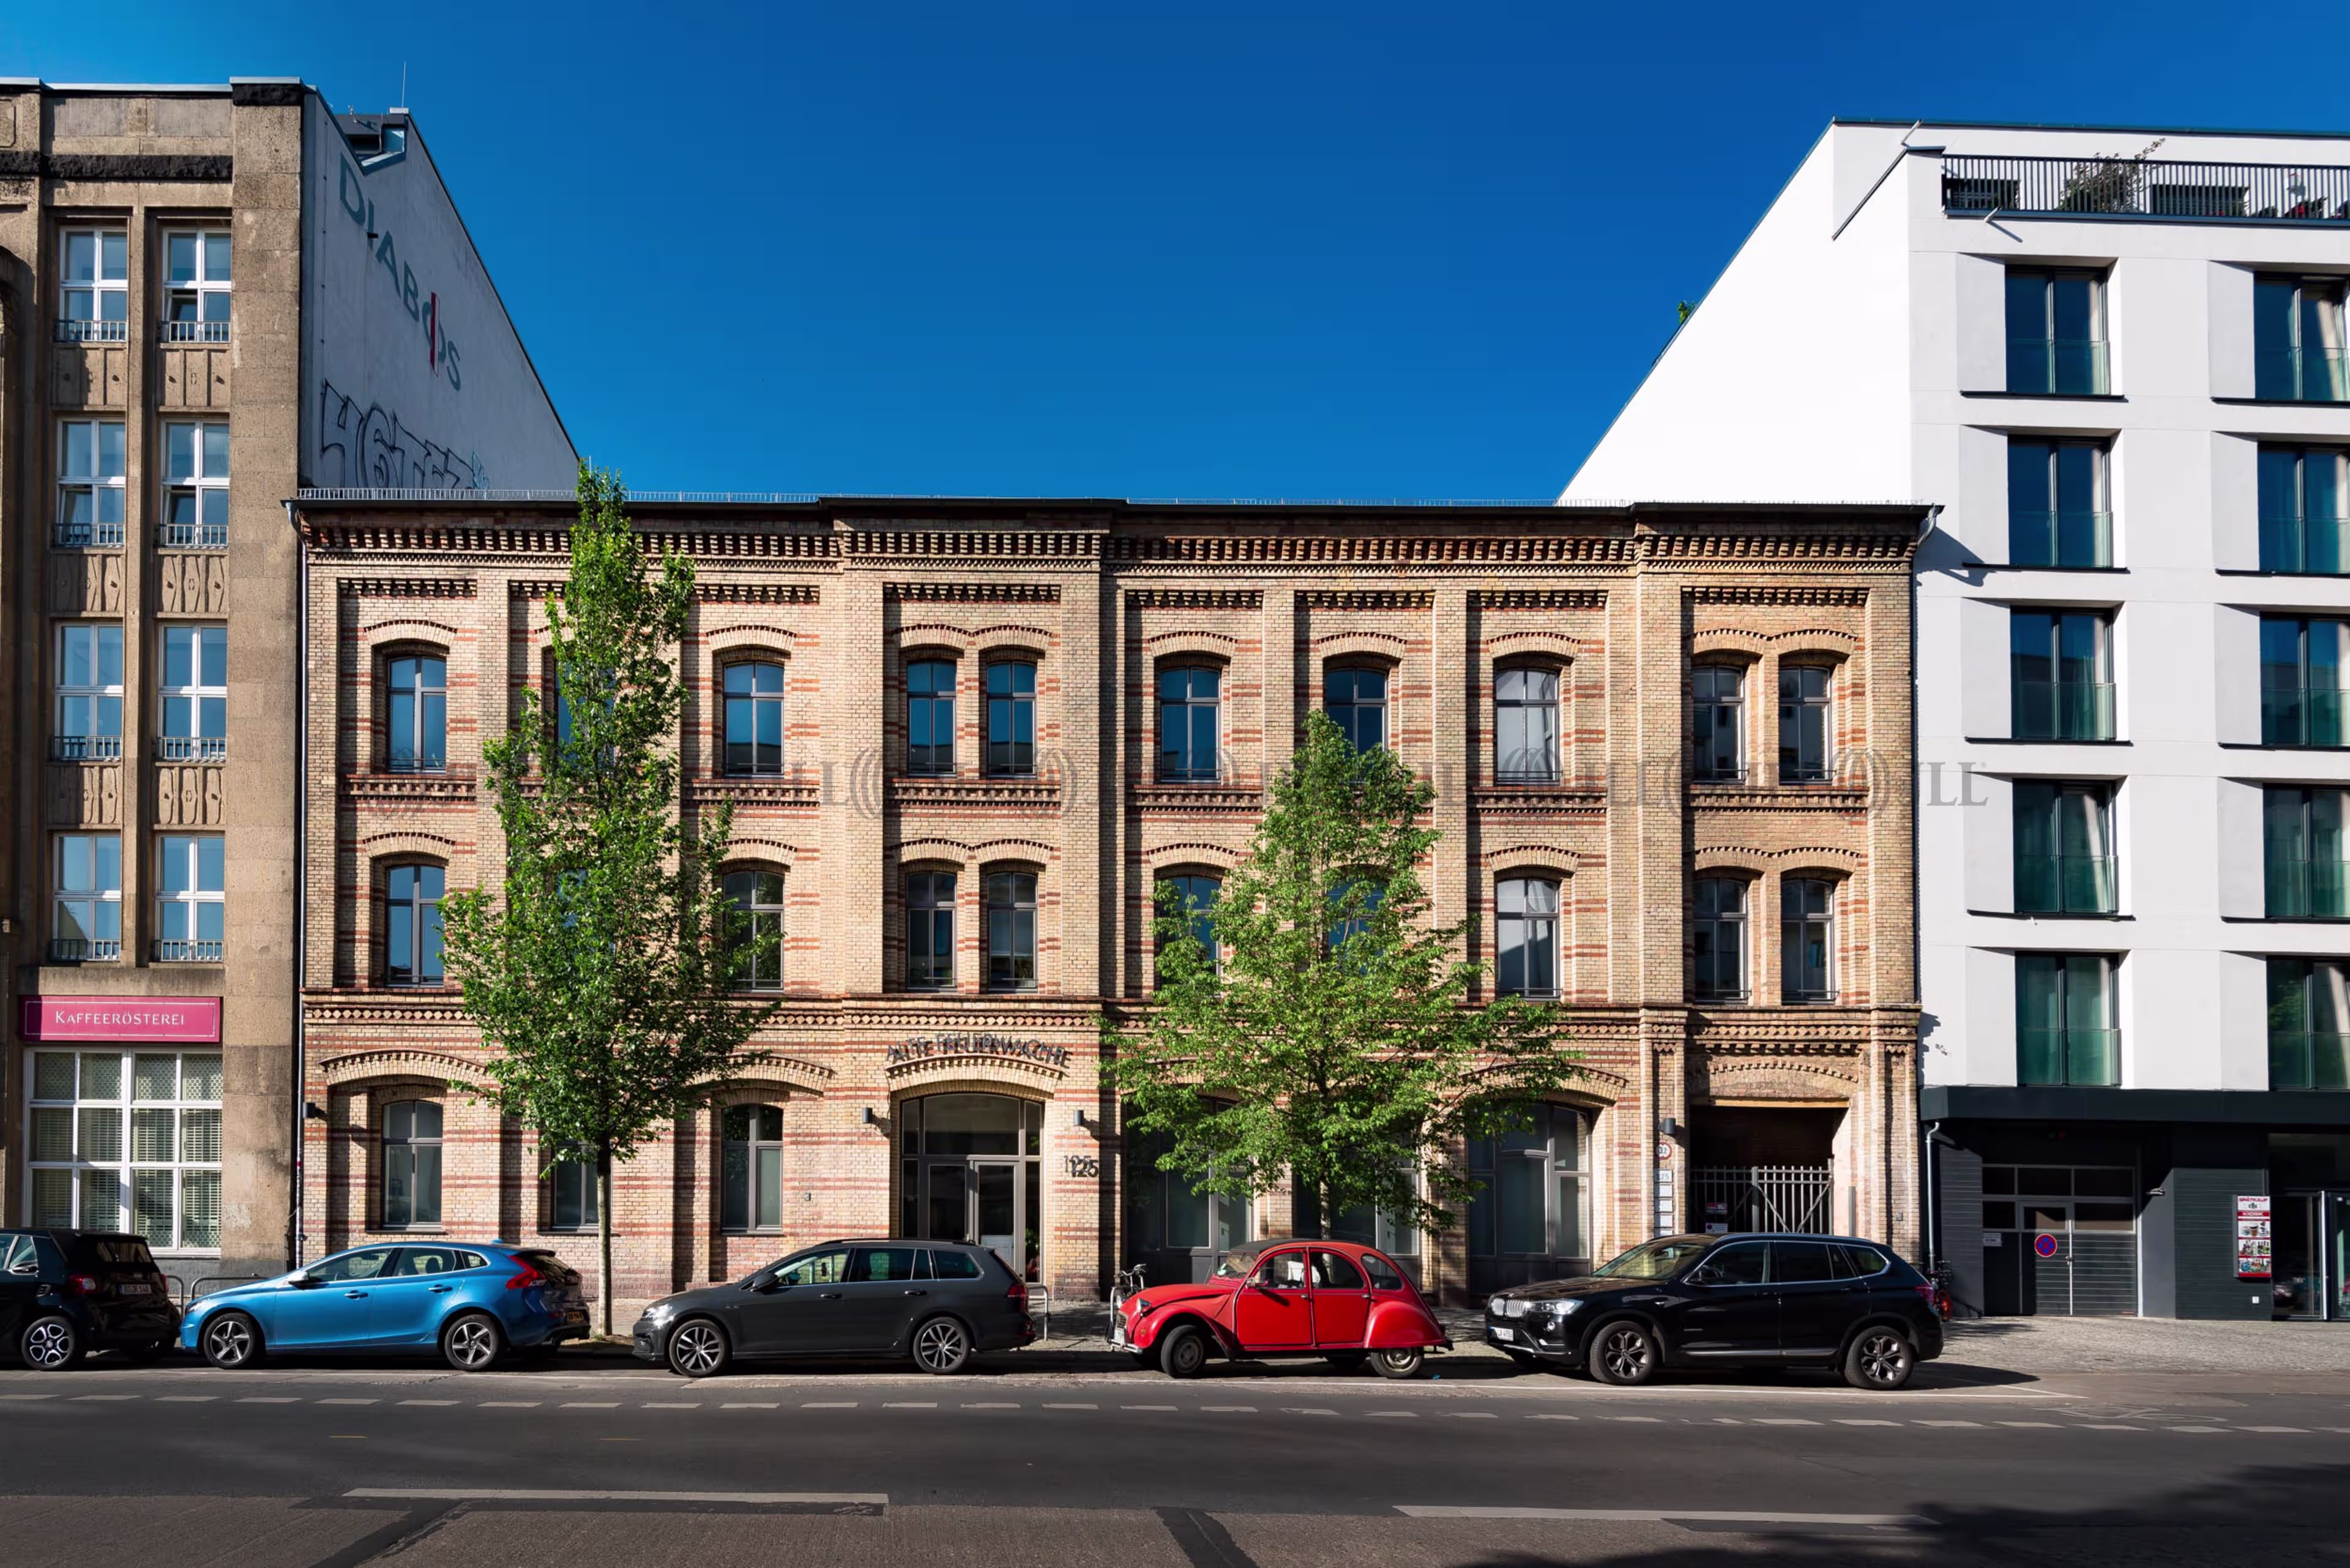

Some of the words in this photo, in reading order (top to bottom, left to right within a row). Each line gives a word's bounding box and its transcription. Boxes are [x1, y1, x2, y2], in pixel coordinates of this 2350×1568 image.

[55, 1010, 184, 1025] KAFFEERÖSTEREI
[887, 1036, 927, 1062] ALTE
[935, 1032, 1068, 1064] FEUERWACHE
[1064, 1155, 1095, 1174] 125
